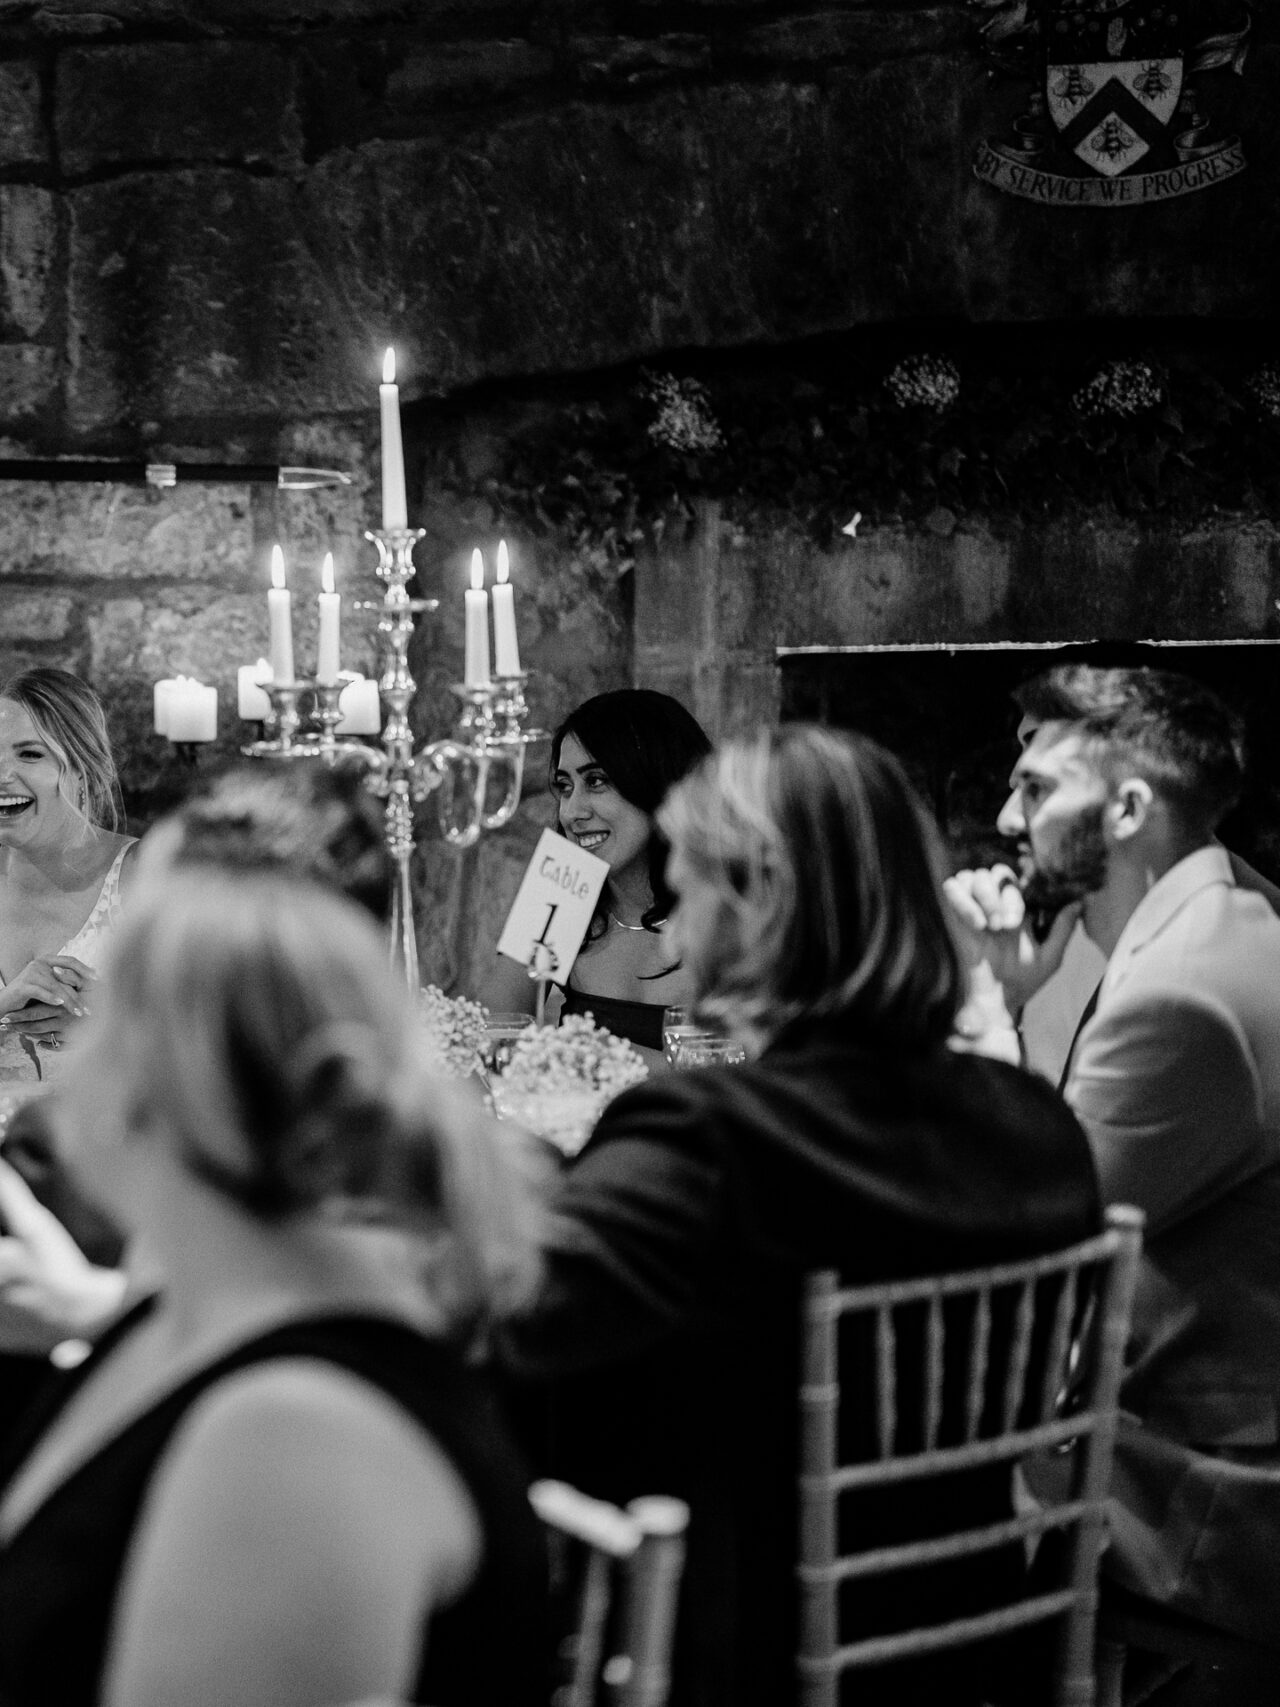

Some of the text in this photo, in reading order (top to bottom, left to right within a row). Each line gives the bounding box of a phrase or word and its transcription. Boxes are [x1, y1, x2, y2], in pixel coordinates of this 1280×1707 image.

[980, 150, 1245, 202] BY SERVICE WE PROGRESS
[539, 855, 590, 898] Table
[533, 903, 558, 944] 1
